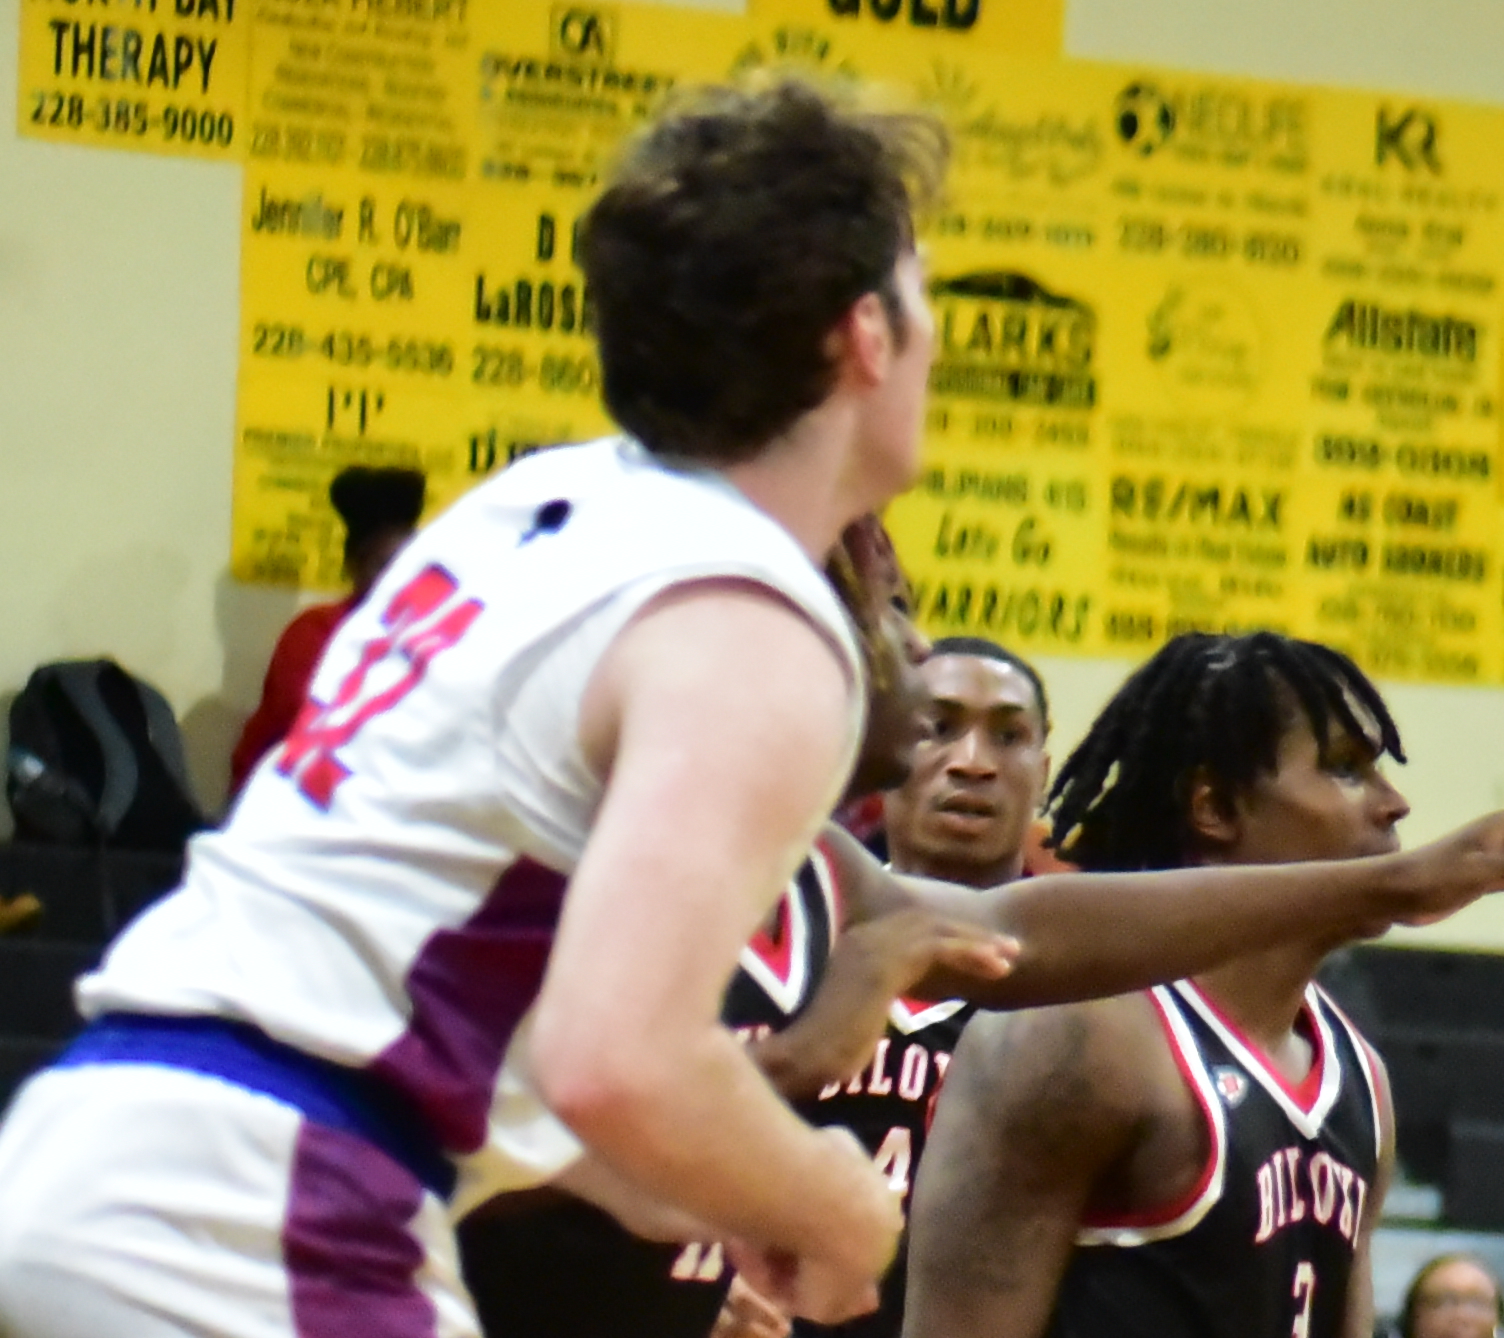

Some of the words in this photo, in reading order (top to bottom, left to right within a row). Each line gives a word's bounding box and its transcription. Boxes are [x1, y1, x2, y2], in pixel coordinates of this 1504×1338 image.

[49, 17, 217, 94] THERAPY
[1321, 298, 1480, 363] Allstate
[1108, 474, 1287, 529] RE/MAX
[1010, 515, 1053, 569] Go
[1254, 1145, 1368, 1249] BILOXI
